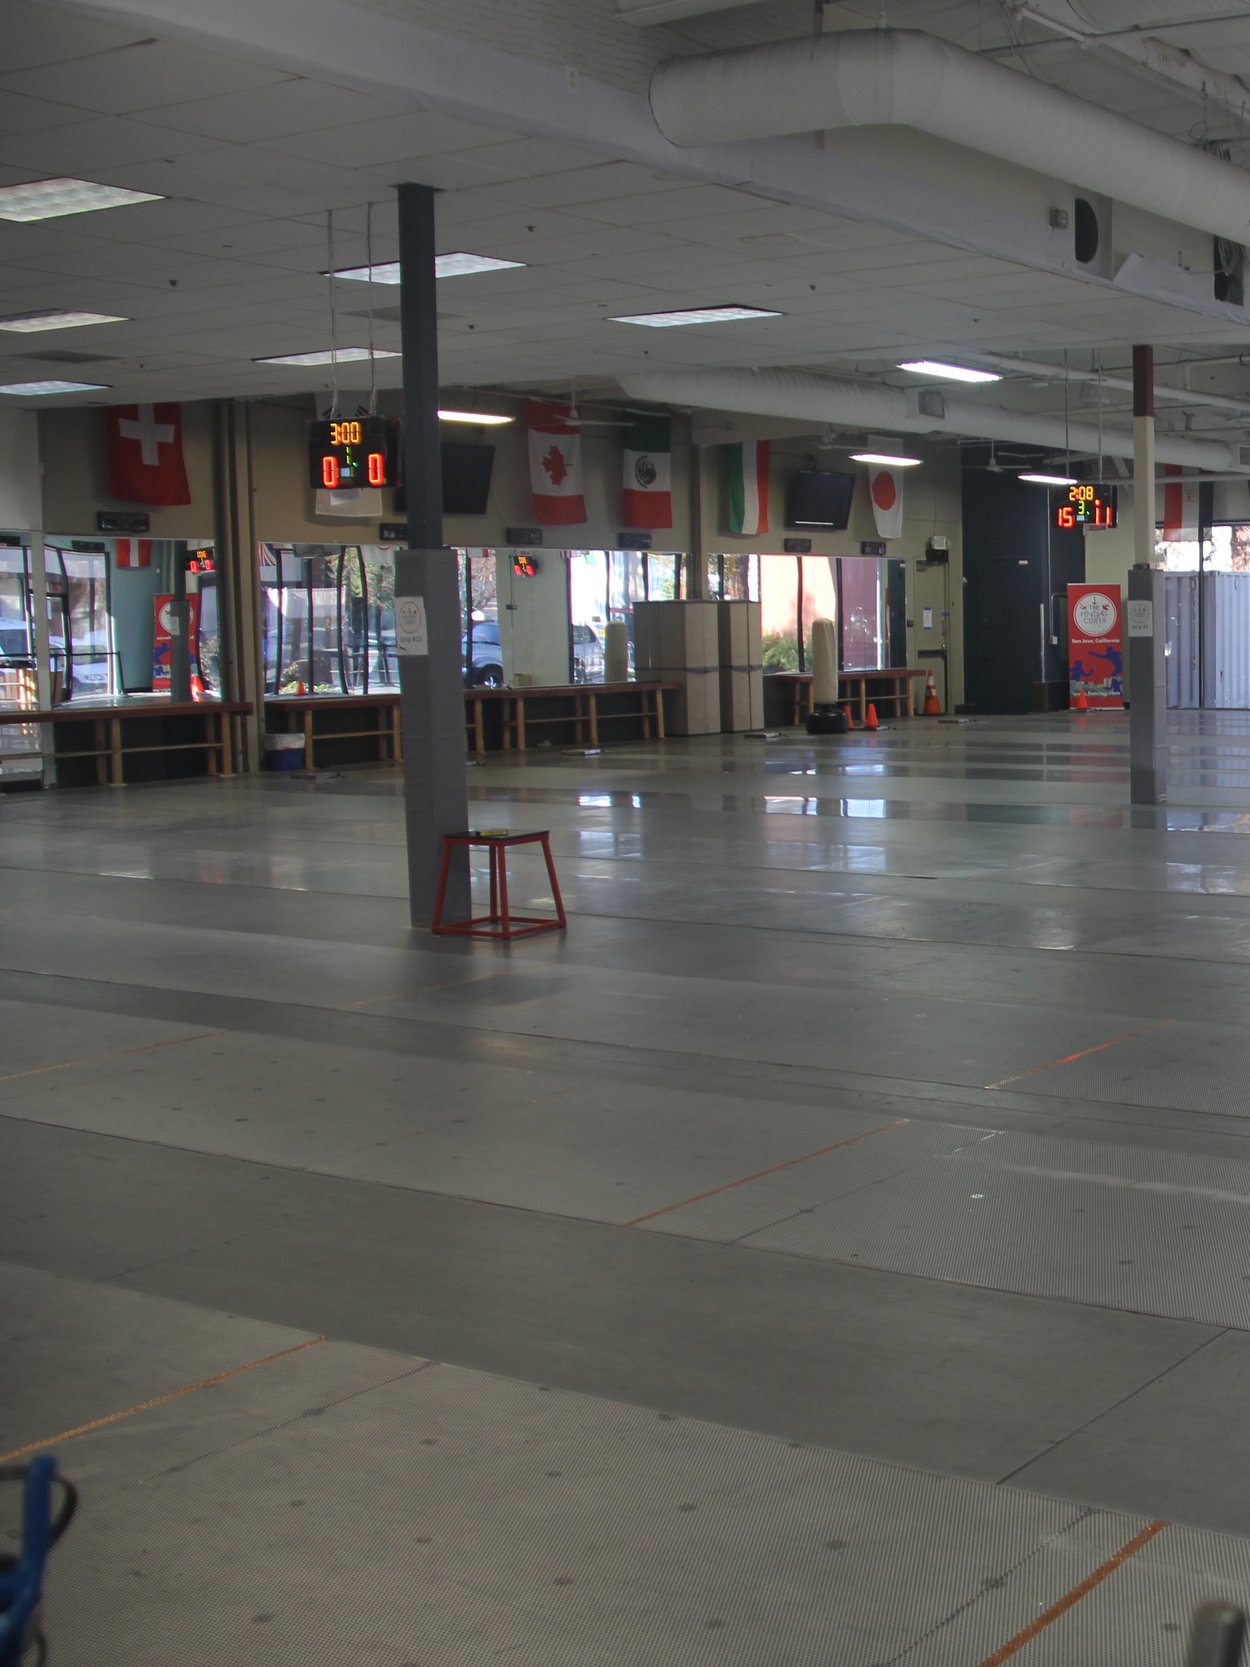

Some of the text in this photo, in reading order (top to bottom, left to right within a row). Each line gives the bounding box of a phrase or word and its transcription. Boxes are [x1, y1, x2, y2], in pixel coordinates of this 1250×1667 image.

[330, 421, 361, 445] 3:00
[323, 456, 338, 487] 0
[369, 453, 383, 485] 0
[1069, 486, 1094, 501] 2:08
[1058, 507, 1074, 528] 15
[1078, 500, 1085, 515] 3
